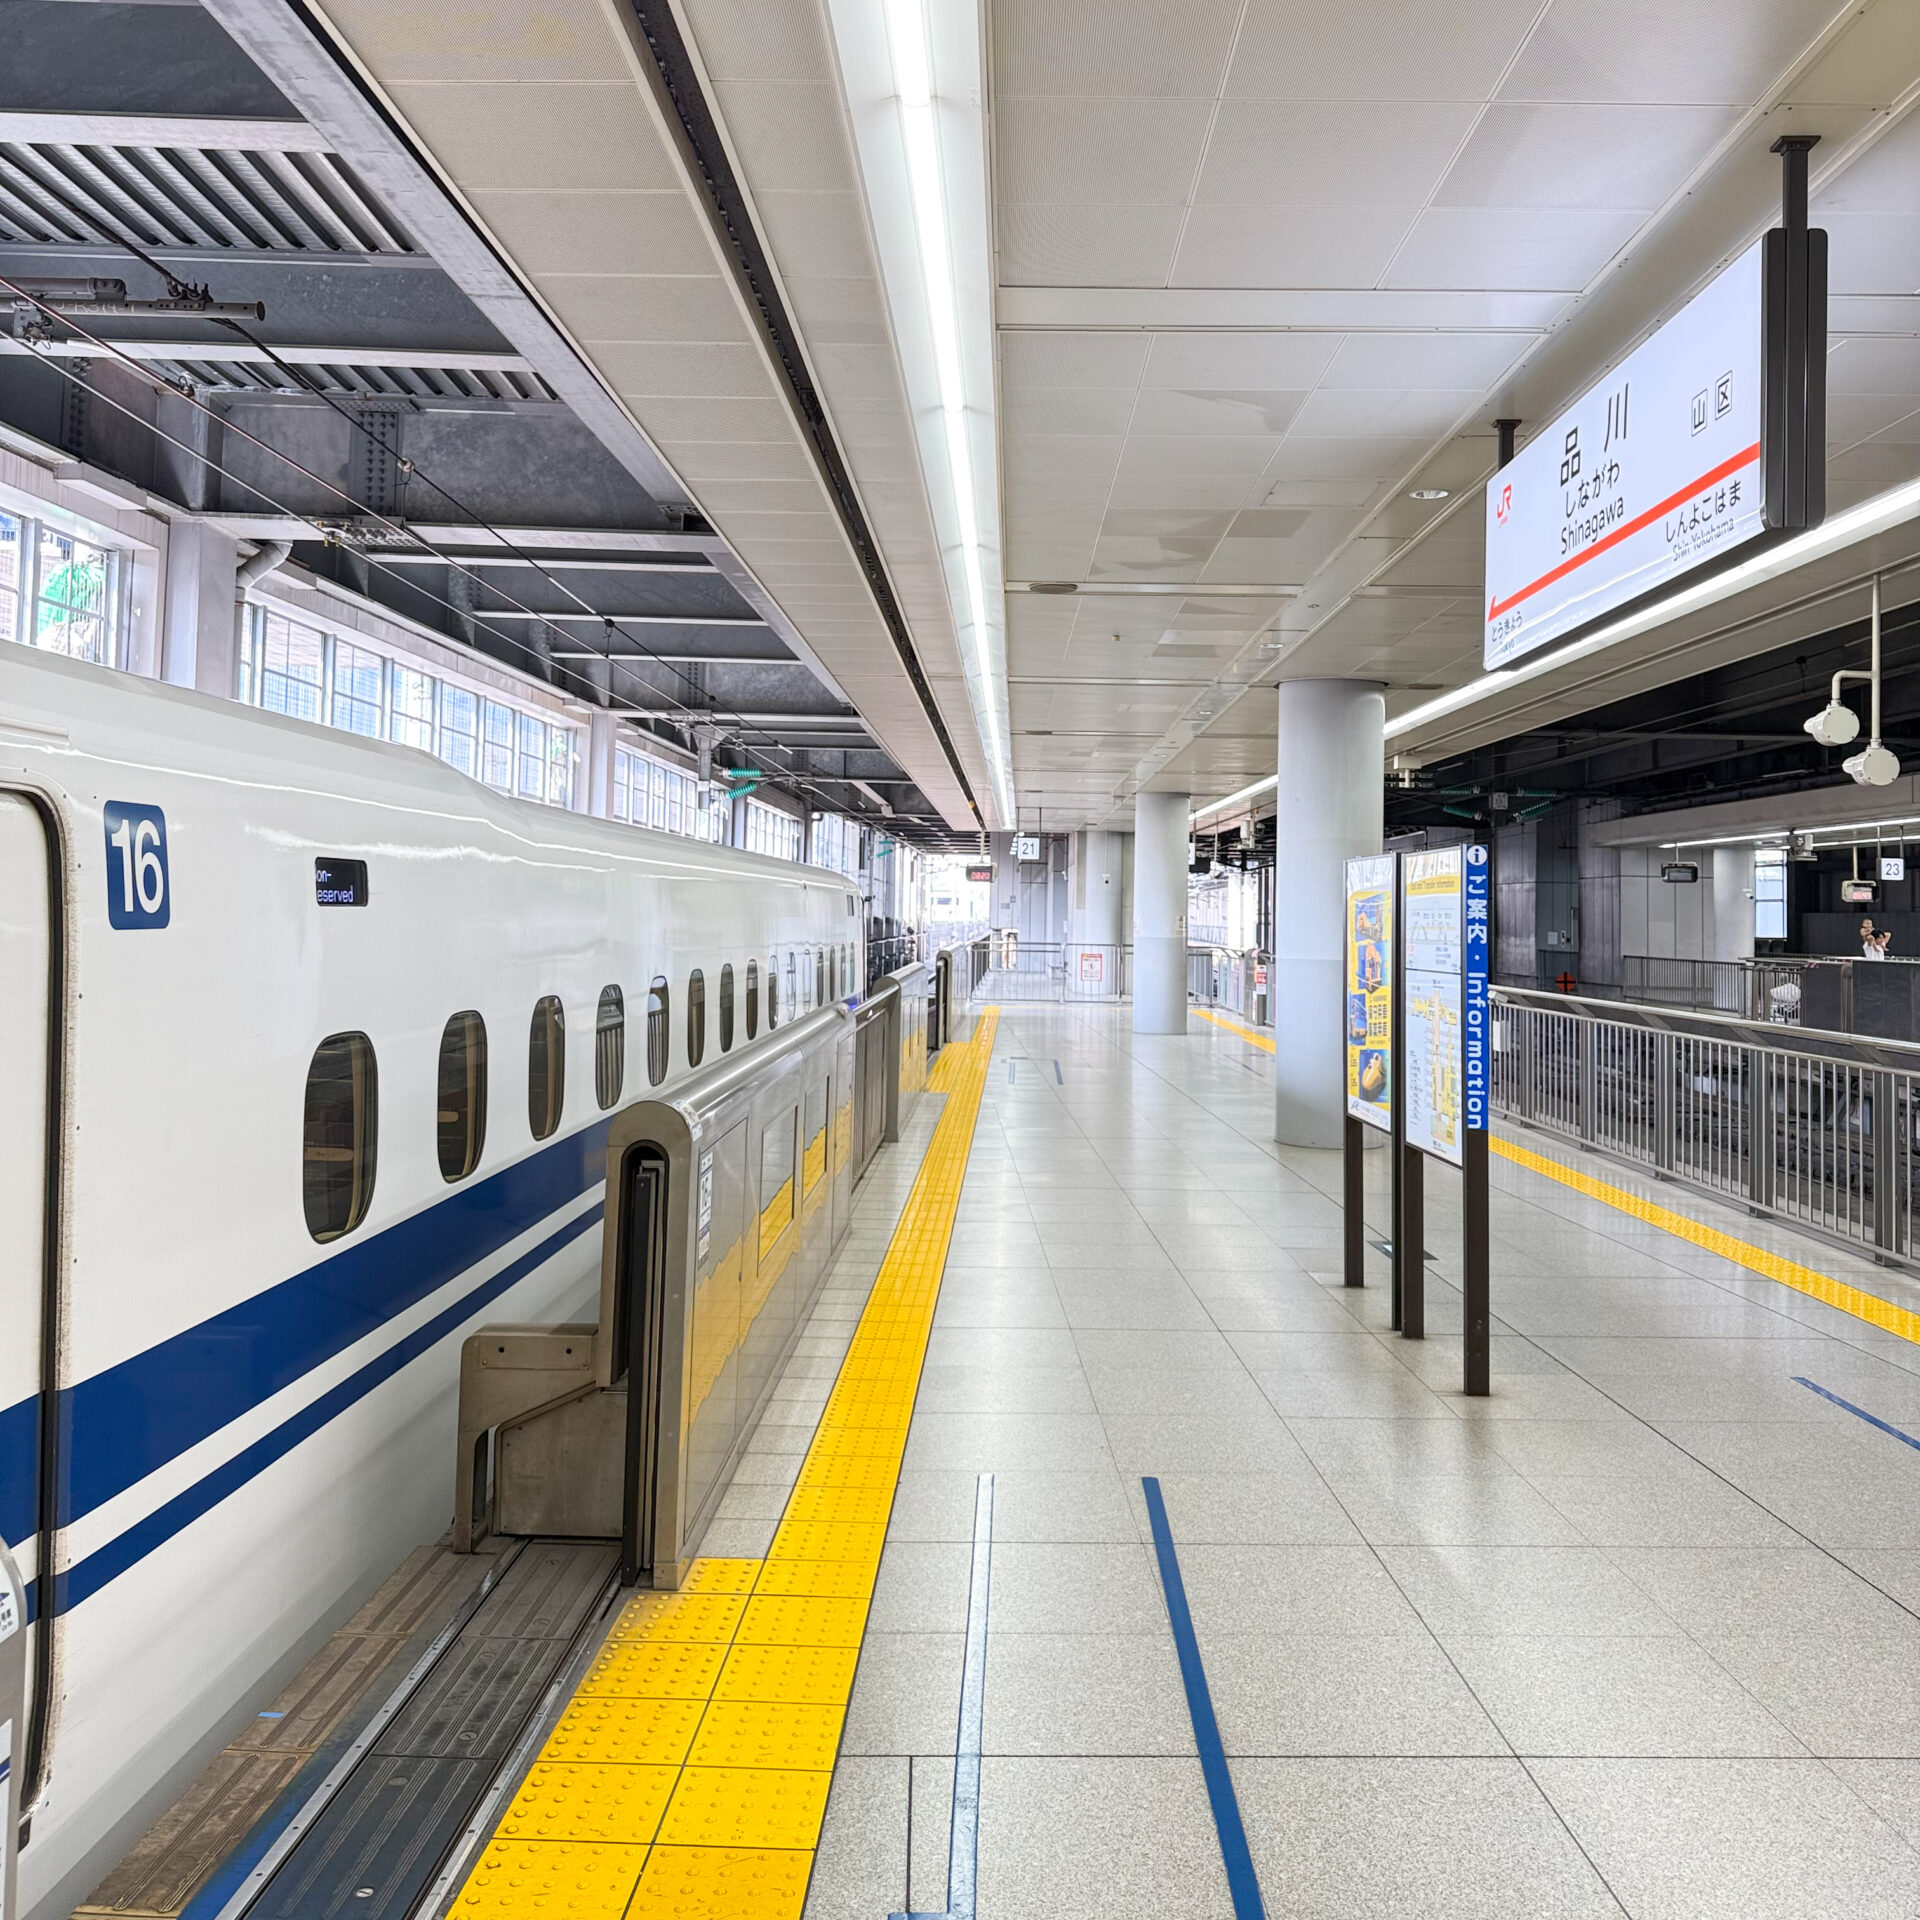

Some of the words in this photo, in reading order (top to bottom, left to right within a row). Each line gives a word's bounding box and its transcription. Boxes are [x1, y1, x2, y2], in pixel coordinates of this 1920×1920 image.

[1693, 398, 1705, 430] 山
[1717, 378, 1730, 414] 区
[1560, 382, 1629, 487] 品川
[1497, 484, 1511, 519] JR
[1566, 458, 1620, 519] しながわ
[1666, 479, 1741, 543] しんよこはま
[1561, 496, 1624, 555] Shinagawa
[1491, 611, 1522, 642] とうきょう
[111, 819, 164, 914] 16
[316, 870, 332, 882] on-
[1022, 842, 1034, 855] 21
[1886, 863, 1900, 876] 23
[316, 884, 354, 902] eserved
[1467, 875, 1487, 944] ご案内
[1467, 972, 1486, 1129] Information
